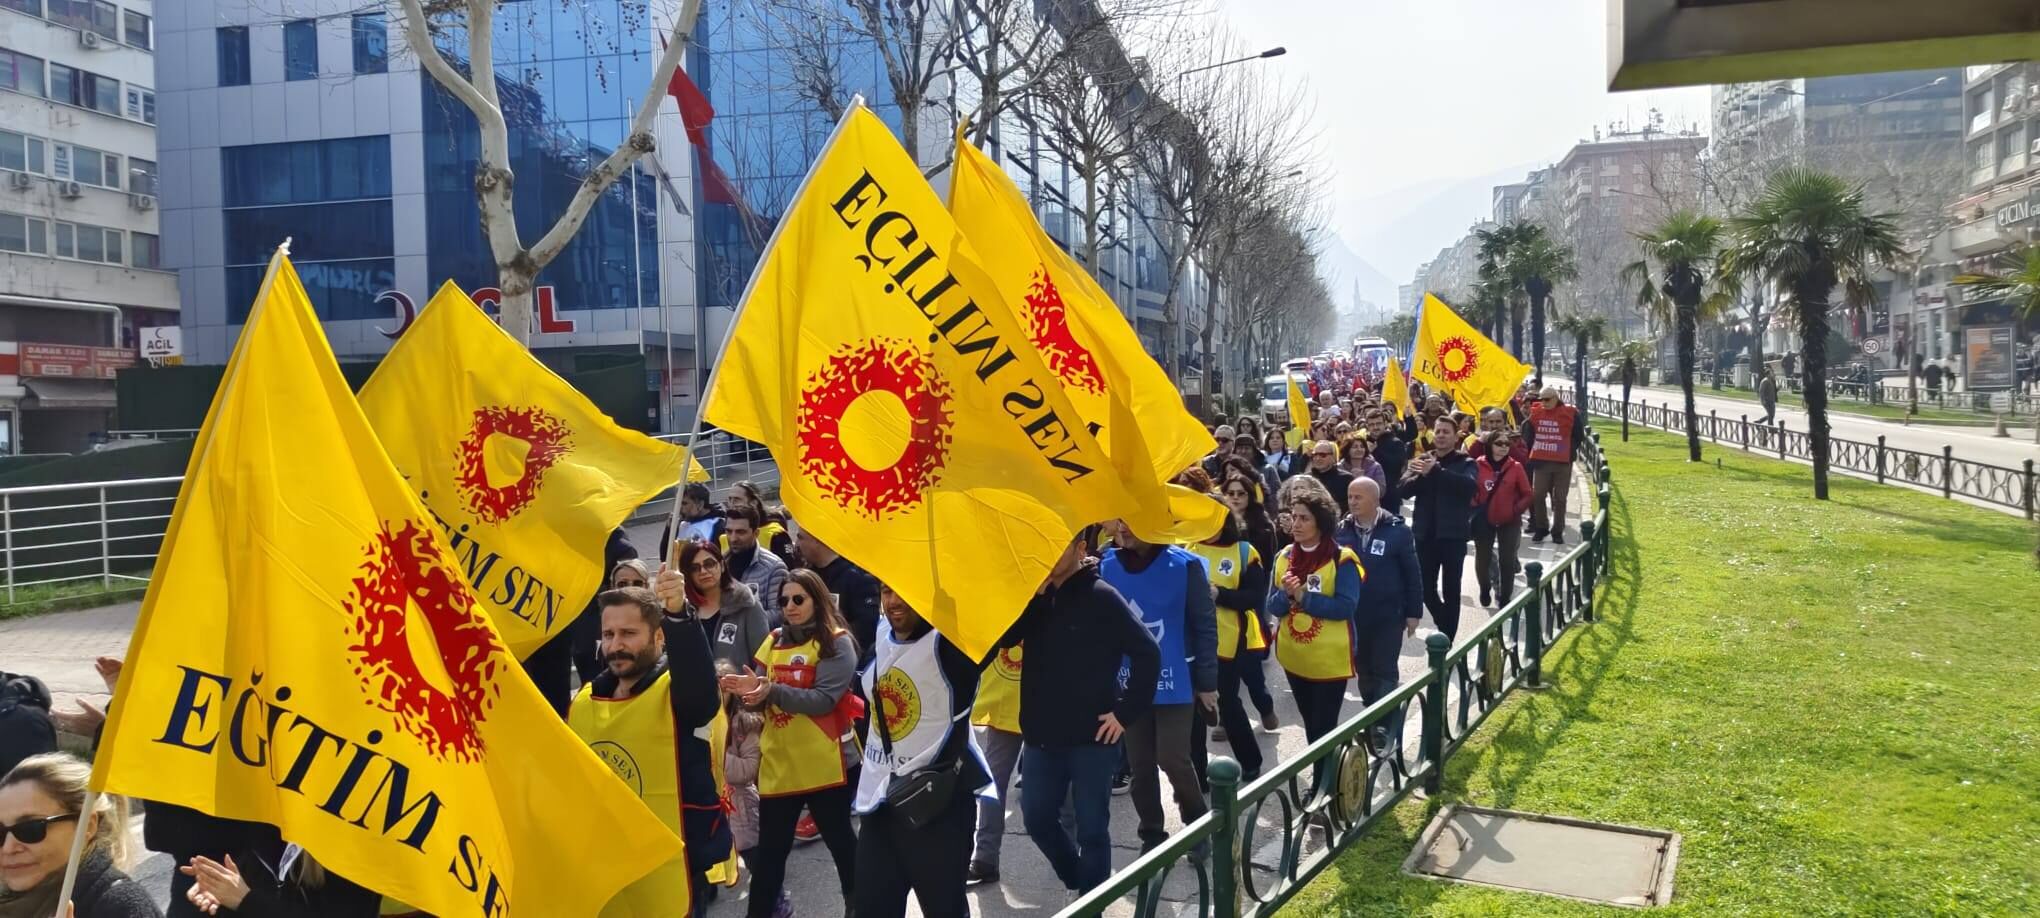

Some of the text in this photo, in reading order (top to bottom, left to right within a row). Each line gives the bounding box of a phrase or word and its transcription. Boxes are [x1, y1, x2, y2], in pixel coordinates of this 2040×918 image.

[1865, 340, 1878, 352] 50
[489, 566, 564, 635] SEN
[611, 754, 634, 780] SEN
[152, 664, 512, 918] EĞİTİM SE
